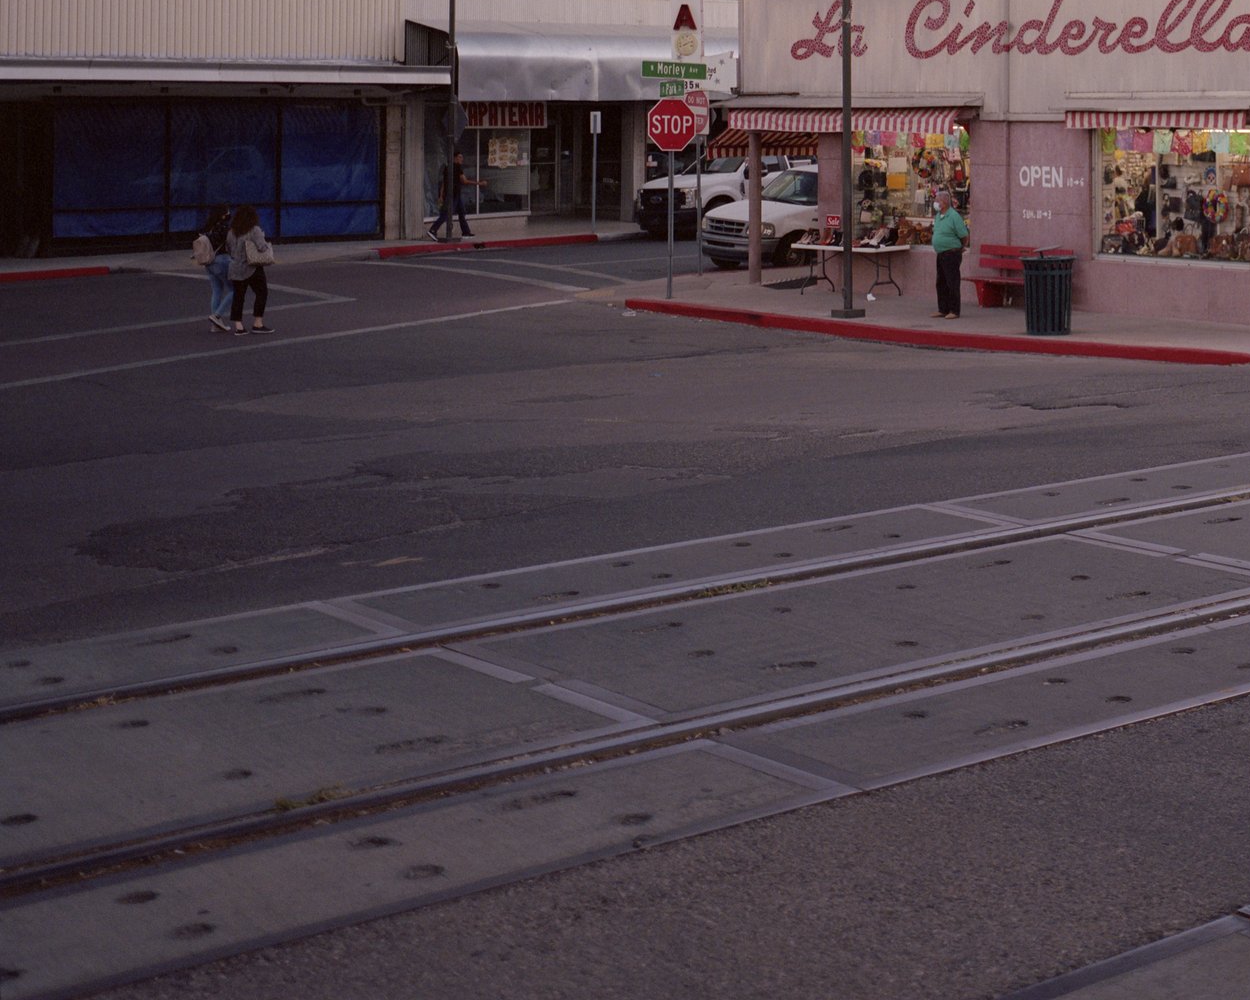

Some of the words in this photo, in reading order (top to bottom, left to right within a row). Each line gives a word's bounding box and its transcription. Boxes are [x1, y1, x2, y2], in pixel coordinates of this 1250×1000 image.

[657, 62, 686, 78] Morley
[689, 66, 698, 74] Ave
[665, 83, 677, 95] Park
[652, 114, 692, 134] STOP
[1019, 165, 1063, 188] OPEN
[827, 217, 840, 226] Sale
